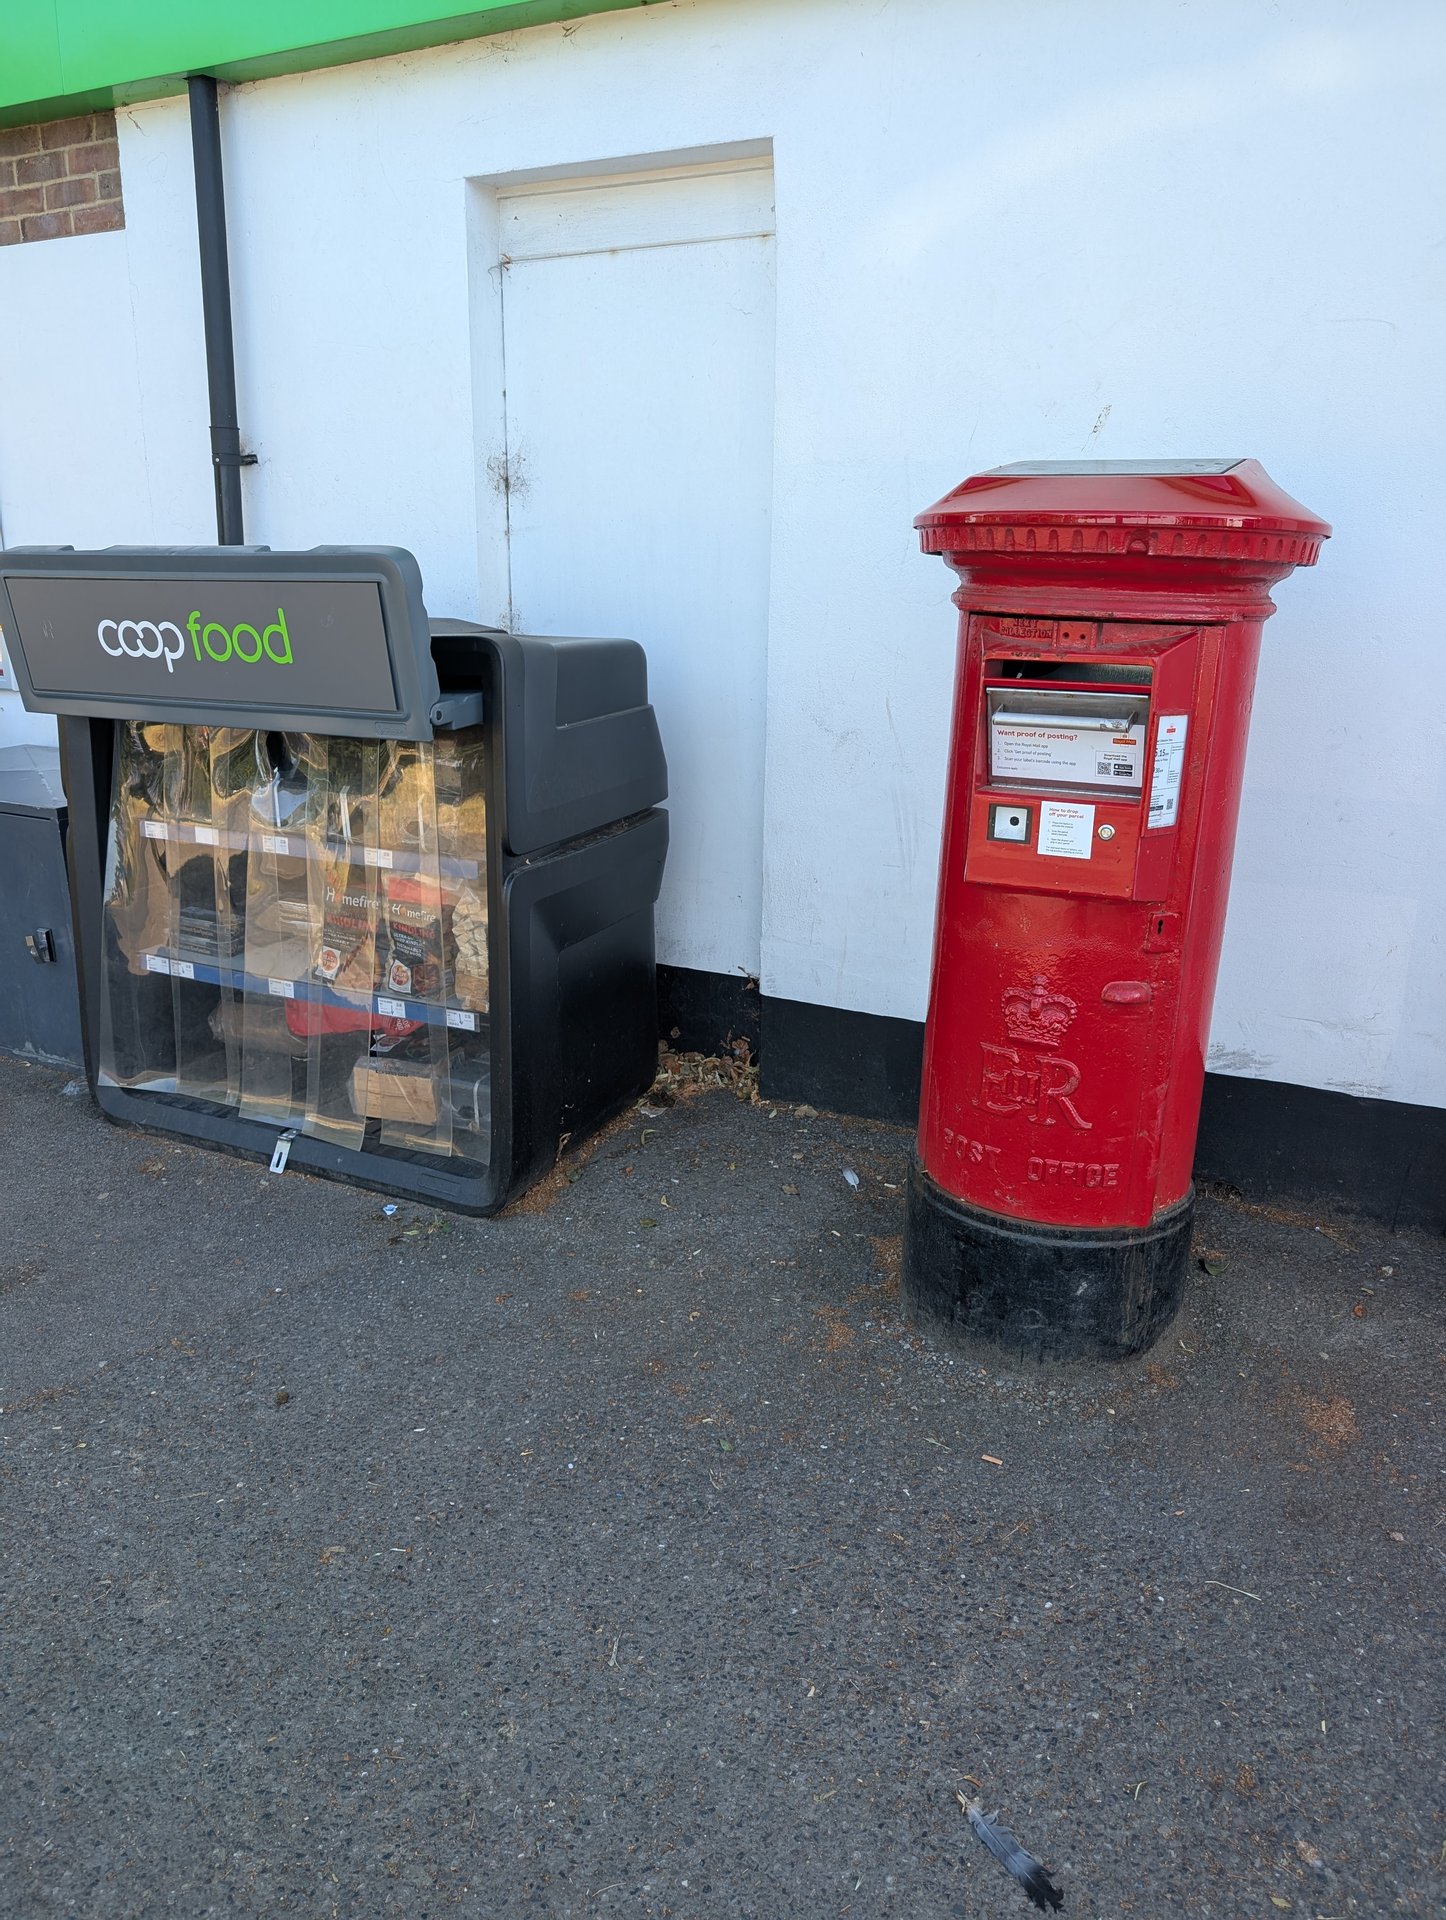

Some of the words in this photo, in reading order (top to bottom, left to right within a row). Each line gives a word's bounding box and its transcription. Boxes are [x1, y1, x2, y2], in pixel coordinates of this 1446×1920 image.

[98, 619, 184, 673] coop
[186, 607, 293, 664] food
[1047, 733, 1078, 741] posting?
[944, 1128, 1002, 1168] POST
[1027, 1156, 1120, 1188] OFFICE
